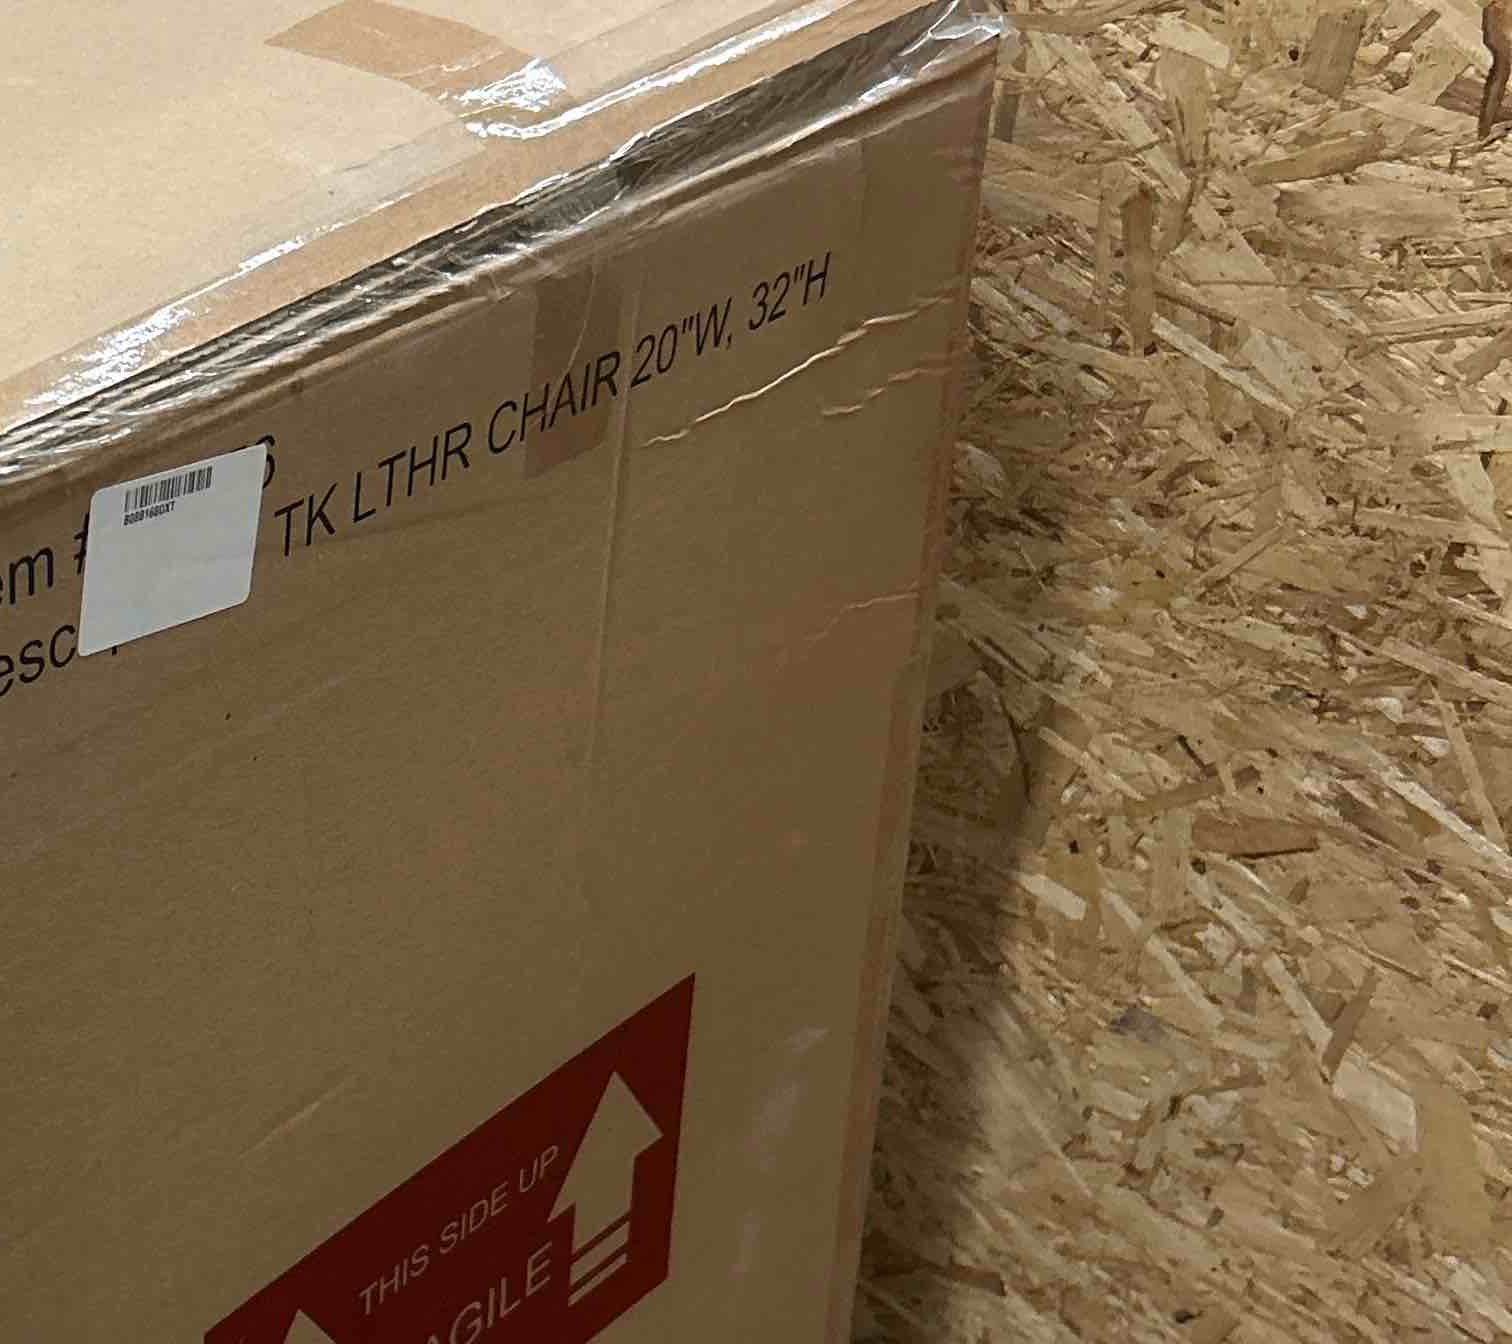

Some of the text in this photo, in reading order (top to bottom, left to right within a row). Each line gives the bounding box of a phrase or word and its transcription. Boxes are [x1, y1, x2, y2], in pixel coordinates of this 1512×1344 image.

[274, 482, 339, 557] TK
[352, 422, 472, 524] LTHR
[488, 351, 621, 454] CHAIR
[748, 251, 831, 331] 32"H
[359, 1144, 559, 1315] THIS SIDE UP
